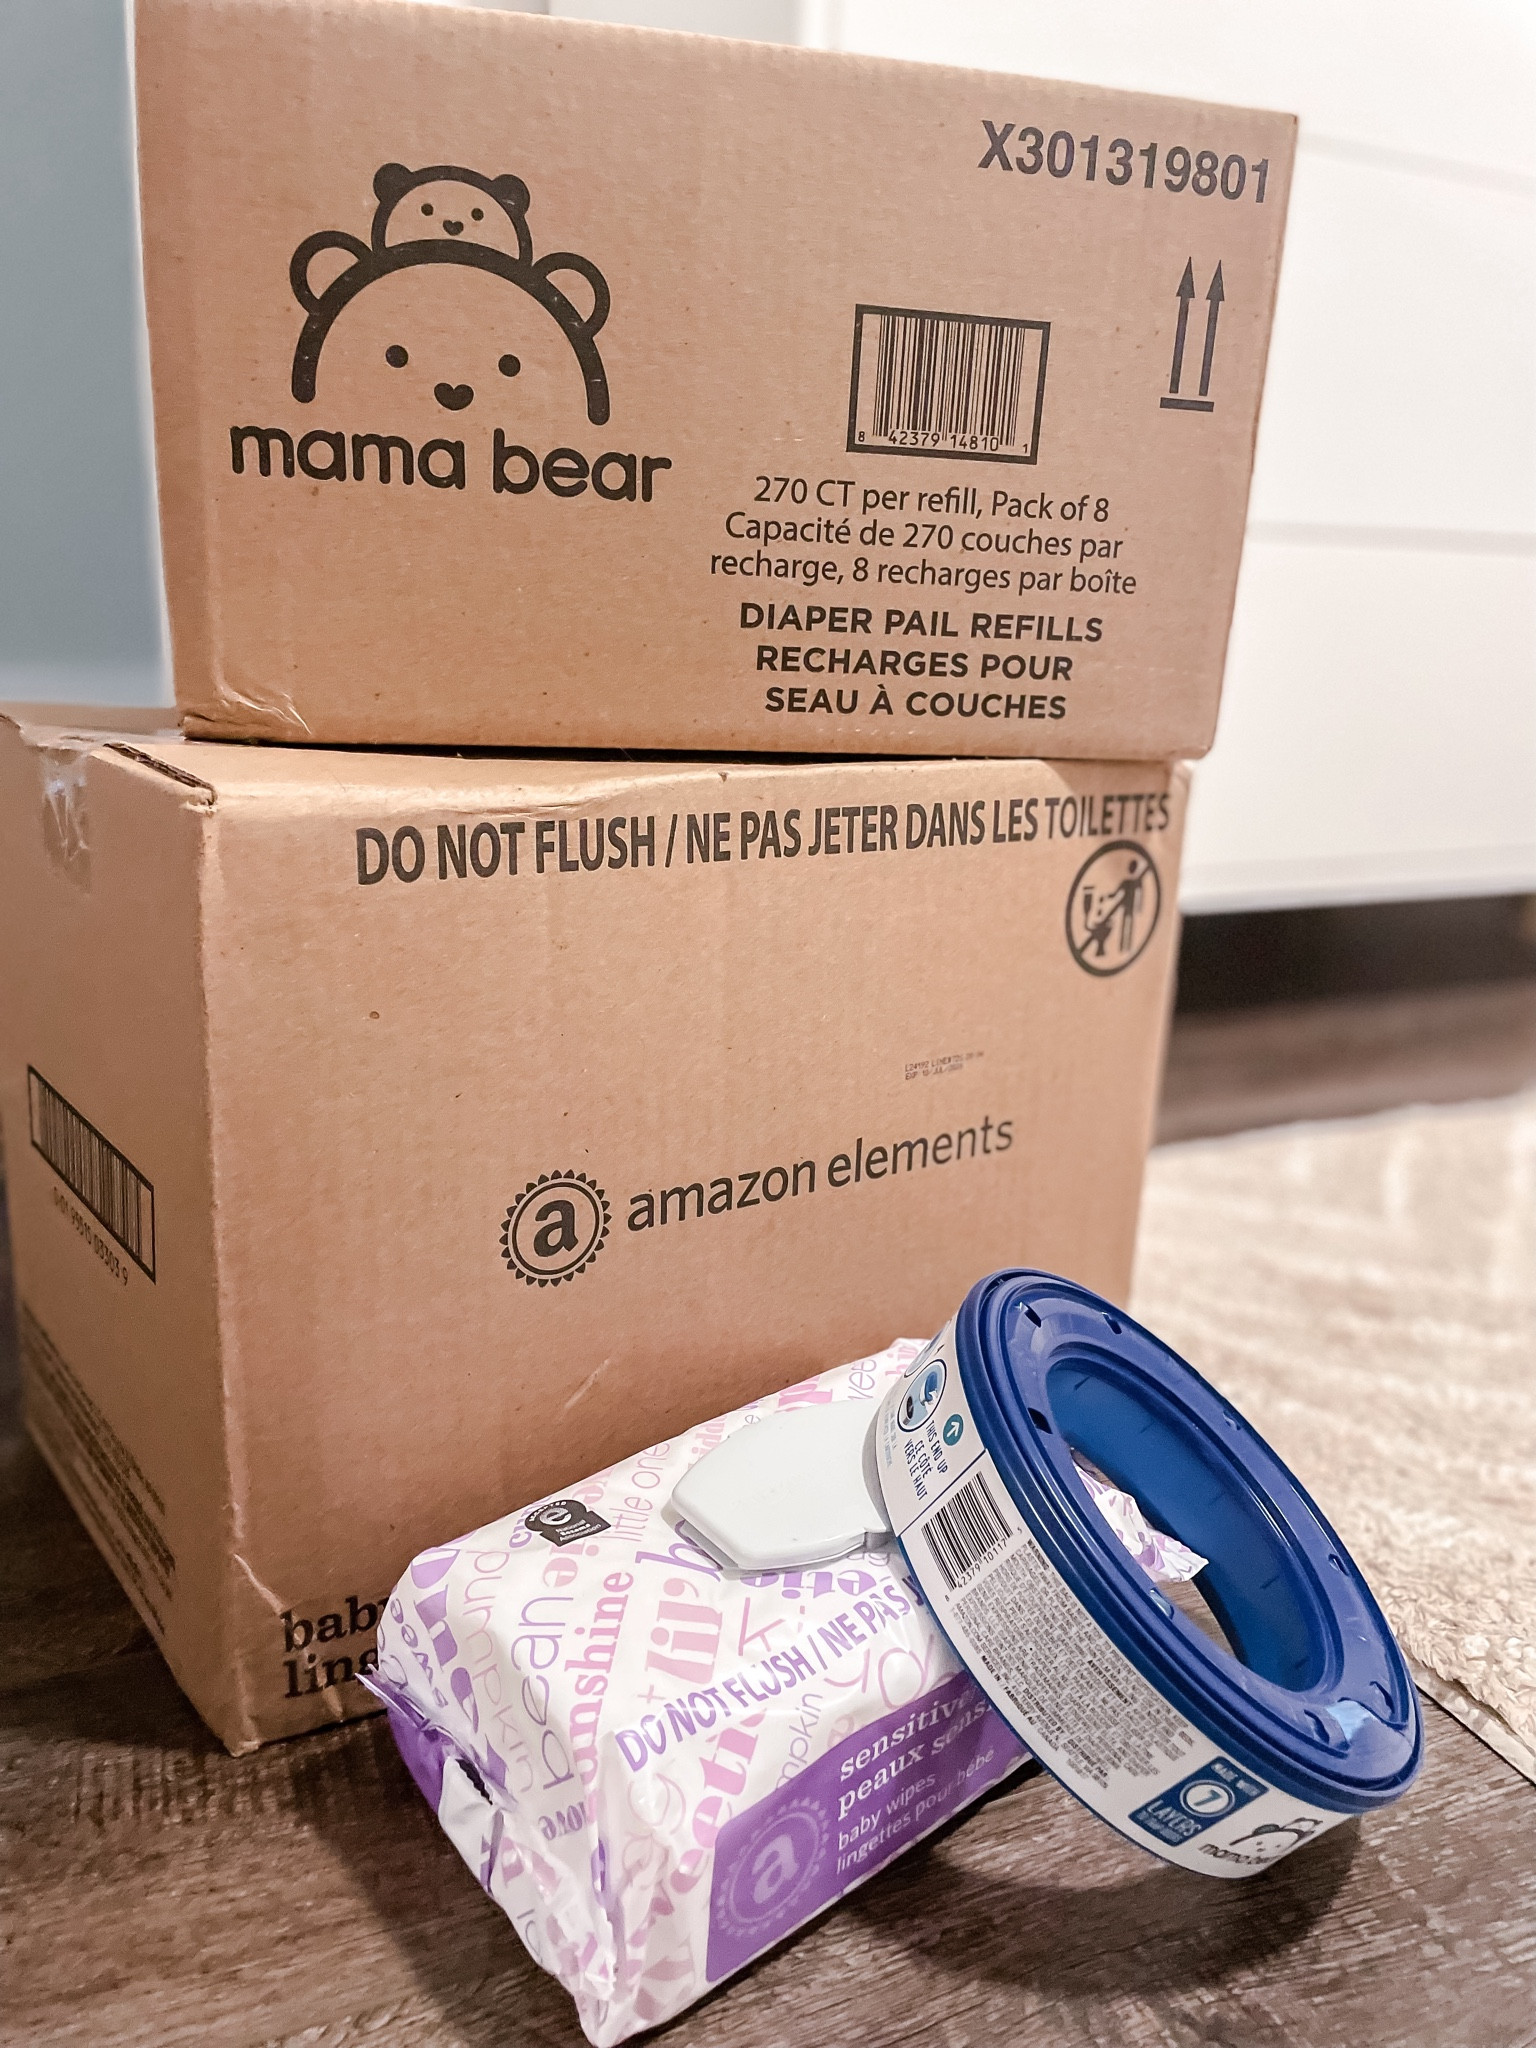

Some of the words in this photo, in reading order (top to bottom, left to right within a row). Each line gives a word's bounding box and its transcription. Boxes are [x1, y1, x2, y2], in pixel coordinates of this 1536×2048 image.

[977, 119, 1270, 204] X301319801
[230, 424, 466, 490] mama
[493, 427, 673, 502] bear
[857, 431, 866, 442] 8
[888, 430, 941, 447] 42379
[950, 434, 999, 451] 14810
[1022, 443, 1028, 454] 1
[753, 475, 809, 504] 270
[815, 479, 856, 507] CT
[861, 486, 910, 515] per
[916, 485, 984, 520] refill,
[990, 490, 1054, 521] Pack
[1059, 495, 1090, 522] of
[1093, 497, 1110, 523] 8
[725, 511, 852, 546] Capacité
[858, 519, 895, 547] de
[902, 523, 954, 550] 270
[960, 528, 1072, 557] couches
[1079, 536, 1125, 563] par
[710, 550, 845, 587] recharge,
[851, 557, 870, 582] 8
[877, 558, 1011, 594] recharges
[1018, 567, 1065, 596] par
[1069, 568, 1137, 595] boîte
[739, 602, 873, 634] DIAPER
[884, 609, 959, 638] PAIL
[970, 612, 1103, 642] REFILLS
[755, 645, 969, 678] RECHARGES
[980, 653, 1074, 681] POUR
[764, 686, 859, 714] SEAU
[868, 684, 895, 716] À
[904, 691, 1067, 720] COUCHES
[356, 824, 426, 886] DO
[436, 821, 526, 880] NOT
[534, 815, 656, 875] FLUSH
[686, 811, 732, 864] NE
[739, 807, 801, 861] PAS
[808, 804, 898, 858] JETER
[905, 800, 986, 850] DANS
[992, 797, 1039, 844] LES
[1044, 793, 1171, 840] TOILETTES
[626, 1157, 817, 1232] amazon
[827, 1115, 1014, 1189] elements
[902, 1438, 916, 1464] VERS
[914, 1439, 924, 1452] CE
[925, 1420, 938, 1442] THIS
[930, 1440, 943, 1461] END
[909, 1463, 917, 1476] LE
[912, 1474, 928, 1500] HAUT
[936, 1459, 948, 1474] UP
[615, 1713, 667, 1772] DO
[663, 1687, 732, 1743] NOT
[721, 1645, 816, 1708] FLUSH
[816, 1612, 867, 1658] NE
[853, 1584, 911, 1634] PAS
[837, 1743, 926, 1822] peaux
[838, 1807, 882, 1851] baby
[886, 1772, 936, 1815] wipes
[836, 1814, 911, 1875] lingettes
